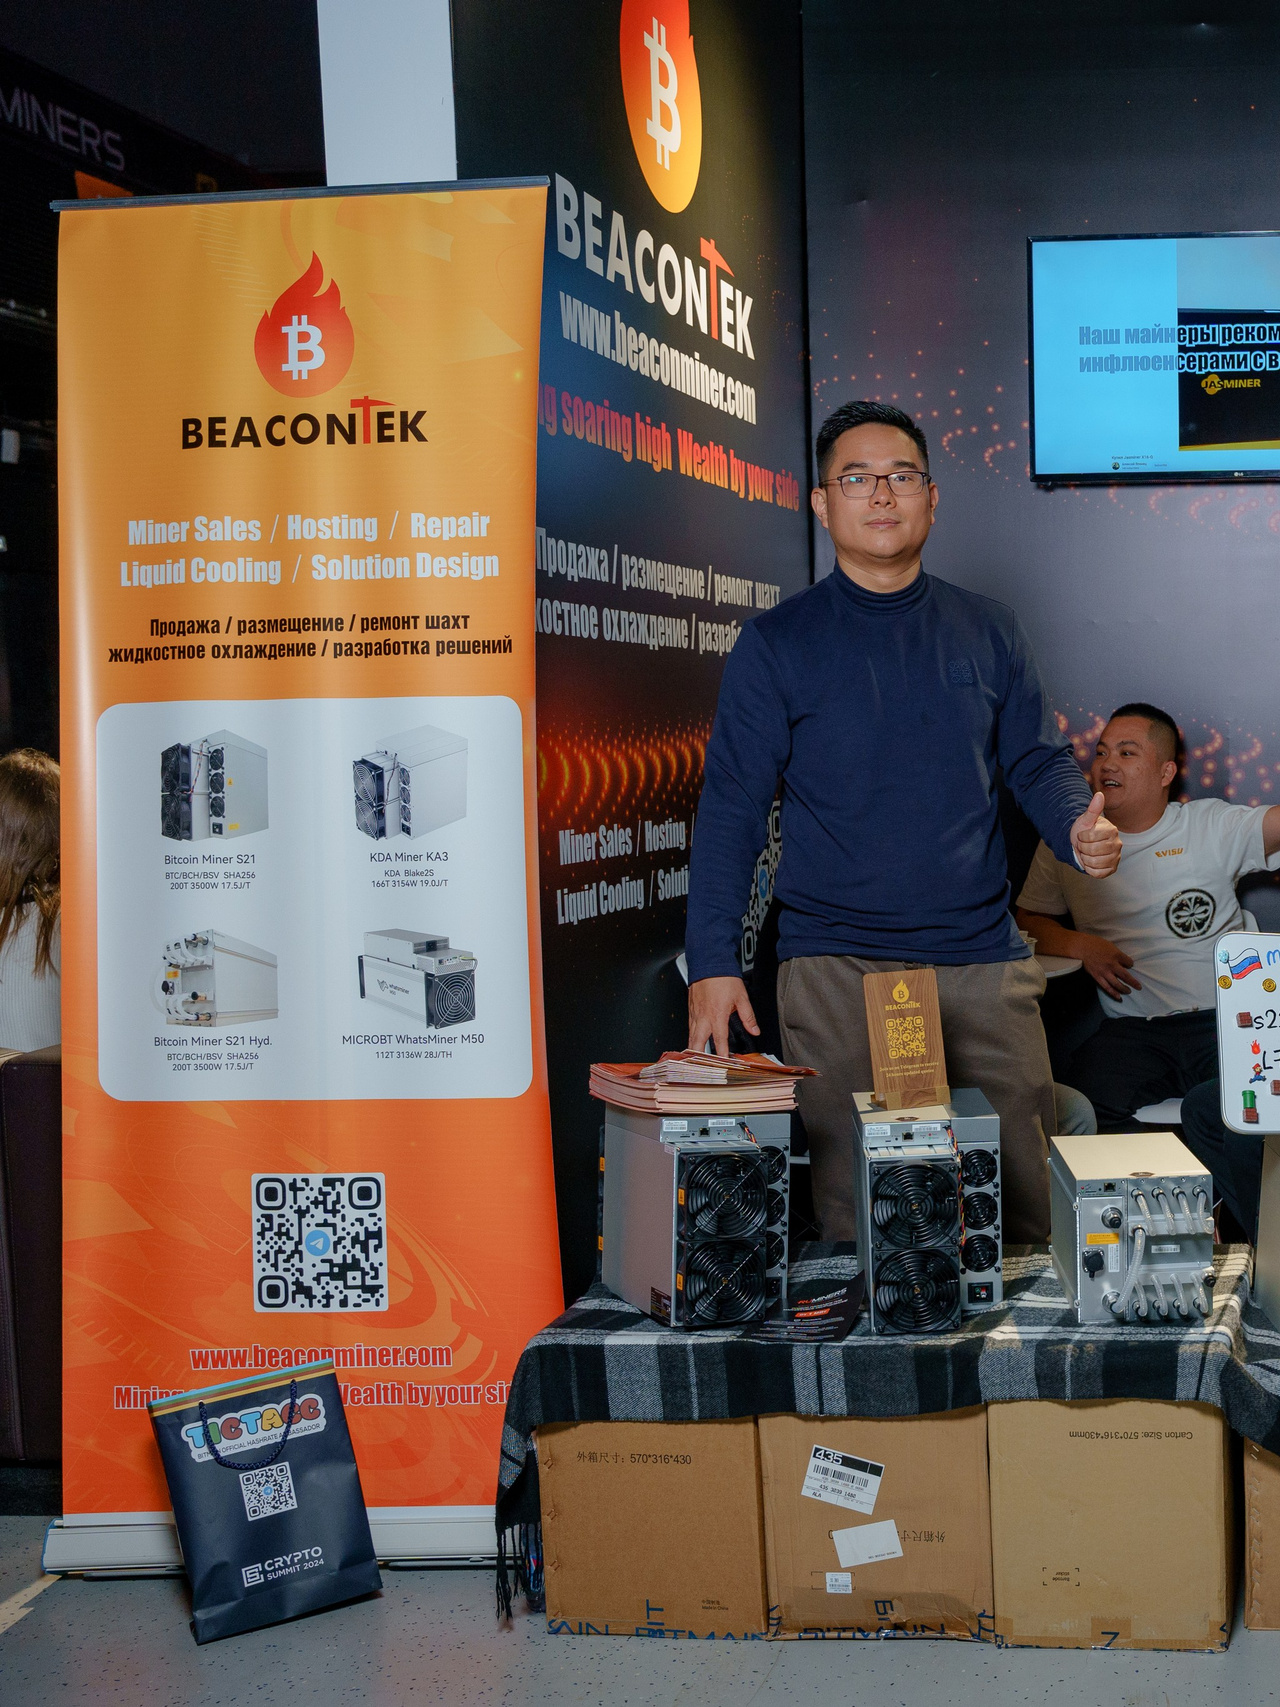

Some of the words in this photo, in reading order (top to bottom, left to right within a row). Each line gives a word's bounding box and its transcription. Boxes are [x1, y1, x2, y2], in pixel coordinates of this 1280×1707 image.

[554, 172, 755, 361] BEACONTEK
[1078, 324, 1121, 346] Наш
[1124, 322, 1218, 347] майнеры
[559, 290, 757, 426] www.beaconminer.com
[1078, 350, 1249, 375] инфлюенсерами
[1201, 377, 1261, 393] JASMINER
[181, 395, 428, 450] BEACONTEK
[561, 390, 632, 464] soaring
[636, 411, 672, 473] high
[677, 427, 728, 490] Wealth
[729, 449, 746, 499] by
[747, 462, 774, 502] your
[775, 469, 800, 512] side
[128, 519, 190, 546] Miner
[194, 515, 262, 543] Sales
[287, 514, 378, 542] Hosting
[411, 511, 490, 540] Repair
[120, 558, 186, 588] Liquid
[191, 557, 281, 585] Cooling
[311, 553, 410, 580] Solution
[416, 552, 499, 581] Design
[535, 526, 609, 584] Продажа
[621, 552, 705, 600] размещение
[714, 573, 753, 607] ремонт
[755, 581, 780, 610] шахт
[150, 617, 221, 637] Продажа
[236, 614, 345, 635] размещение
[360, 613, 420, 634] ремонт
[425, 613, 470, 631] шахт
[602, 608, 688, 651] охлаждение
[108, 642, 206, 663] жидкостное
[211, 640, 316, 661] охлаждение
[333, 636, 430, 659] разработка
[435, 634, 512, 658] решений
[559, 827, 597, 866] Miner
[599, 824, 633, 861] Sales
[644, 818, 687, 853] Hosting
[1155, 848, 1184, 857] EVISU
[164, 855, 199, 865] Bitcoin
[202, 854, 234, 864] Miner
[236, 854, 255, 864] S21
[370, 852, 392, 862] KDA
[395, 852, 423, 862] Miner
[426, 852, 449, 861] KA3
[223, 871, 256, 879] SHA256
[372, 880, 390, 888] 166T
[420, 879, 448, 887] 19.0J/T
[404, 869, 434, 877] Blake2S
[170, 882, 188, 890] 200T
[221, 881, 251, 889] 17.5J/T
[556, 882, 597, 925] Liquid
[599, 877, 645, 915] Cooling
[657, 864, 690, 901] Soluti
[885, 1001, 921, 1011] BEACONTEK
[154, 1036, 188, 1047] Bitcoin
[191, 1036, 223, 1046] Miner
[225, 1036, 245, 1046] S21
[249, 1035, 273, 1048] Hyd.
[342, 1034, 393, 1045] MICROBT
[395, 1034, 458, 1044] WhatsMiner
[461, 1033, 485, 1044] M50
[167, 1053, 223, 1061] BTC/BCH/BSV
[376, 1051, 395, 1059] 112T
[396, 1051, 423, 1059] 3136W
[424, 1050, 452, 1059] 28J/TH
[172, 1063, 191, 1071] 200T
[193, 1063, 222, 1071] 3500W
[190, 1343, 453, 1370] www.beaconminer.com
[407, 1382, 432, 1407] by
[435, 1384, 482, 1407] your
[222, 1442, 247, 1454] OFFICIAL
[247, 1433, 278, 1447] HASHRATE
[279, 1422, 320, 1439] ABASSADOR
[1141, 1431, 1163, 1440] Size:
[1165, 1431, 1193, 1440] Carton
[815, 1449, 843, 1465] 435
[264, 1546, 322, 1571] CRYPTO
[267, 1564, 301, 1580] SUMMIT
[303, 1558, 325, 1570] 2024
